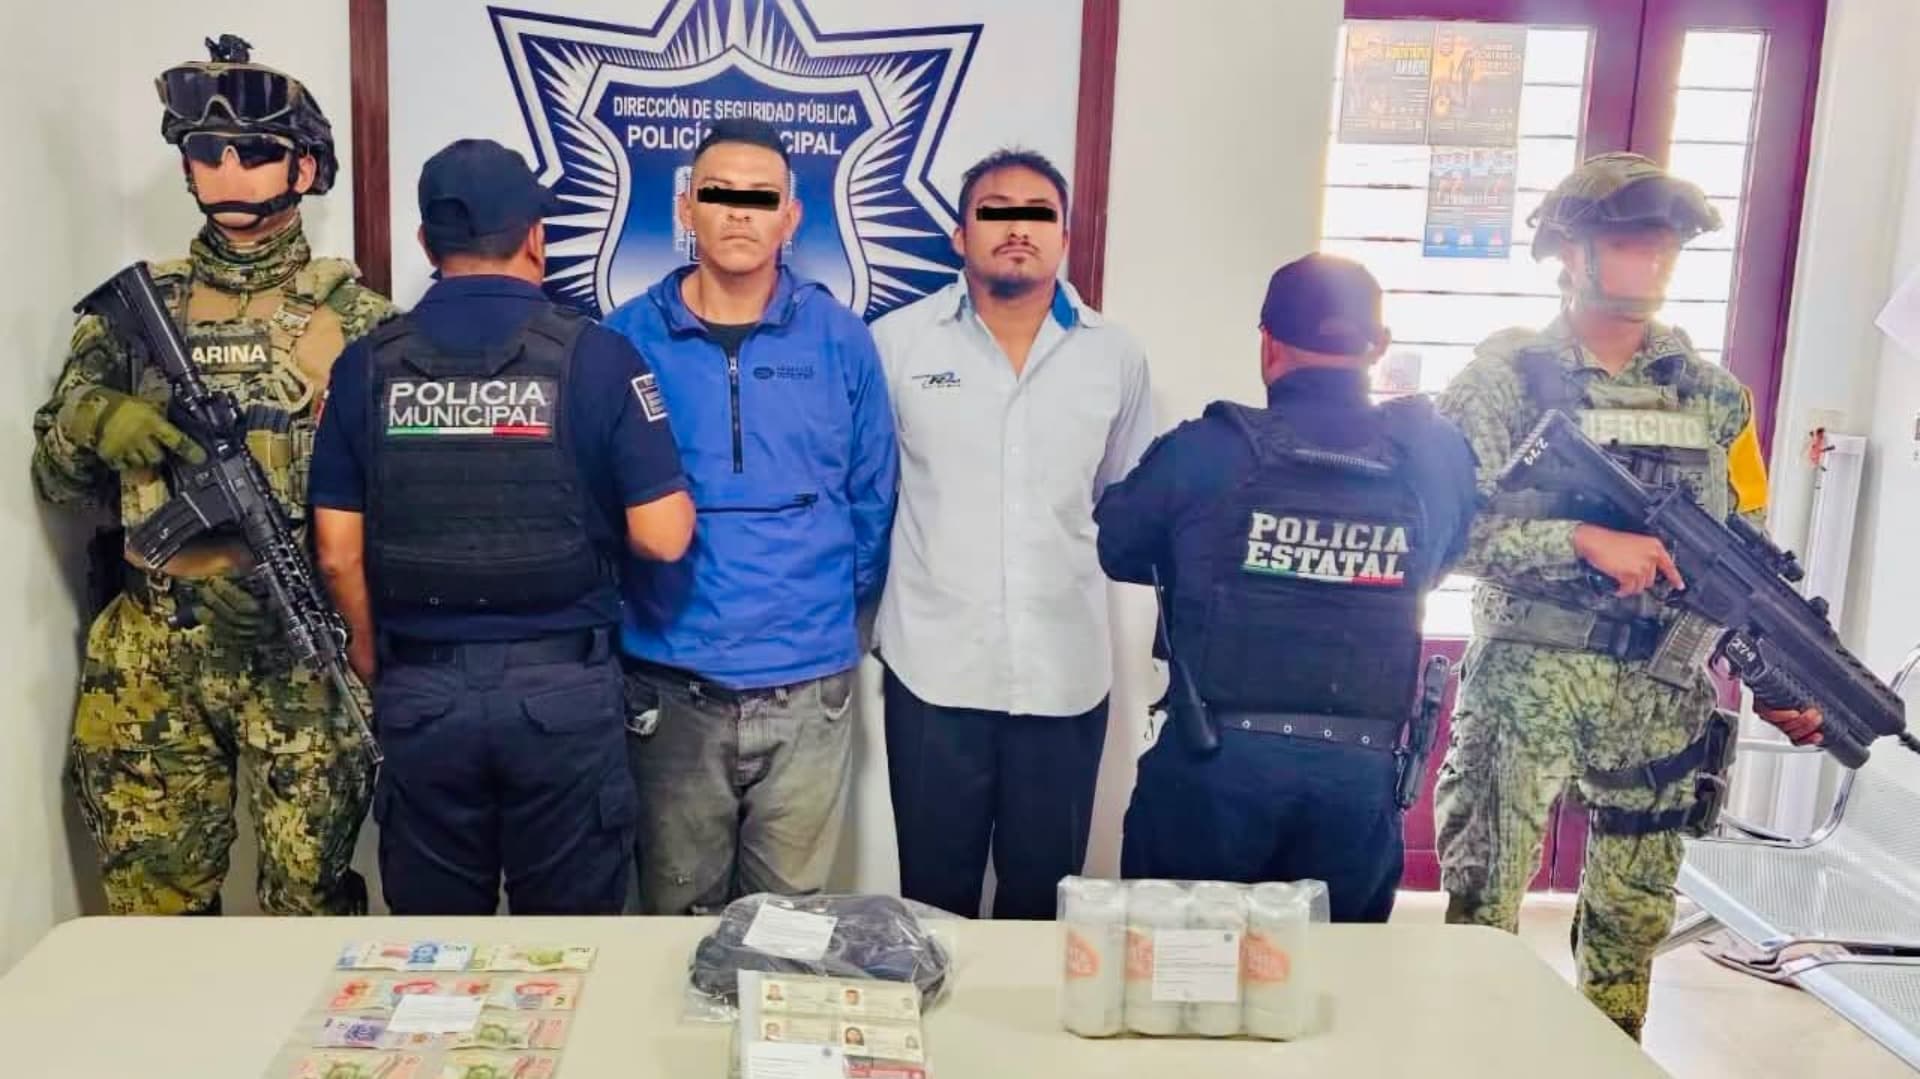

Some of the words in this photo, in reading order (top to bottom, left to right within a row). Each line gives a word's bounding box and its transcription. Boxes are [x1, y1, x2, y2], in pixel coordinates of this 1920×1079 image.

[613, 94, 690, 119] DIRECCIÓN
[692, 98, 712, 120] DE
[714, 100, 794, 123] SEGURIDAD
[798, 98, 857, 125] PÚBLICA
[780, 131, 842, 155] CIPAL
[192, 344, 267, 364] ARINA
[389, 381, 546, 406] POLICIA
[388, 404, 550, 426] MUNICIPAL
[1250, 512, 1409, 553] POLICIA
[1247, 540, 1405, 579] ESTATAL
